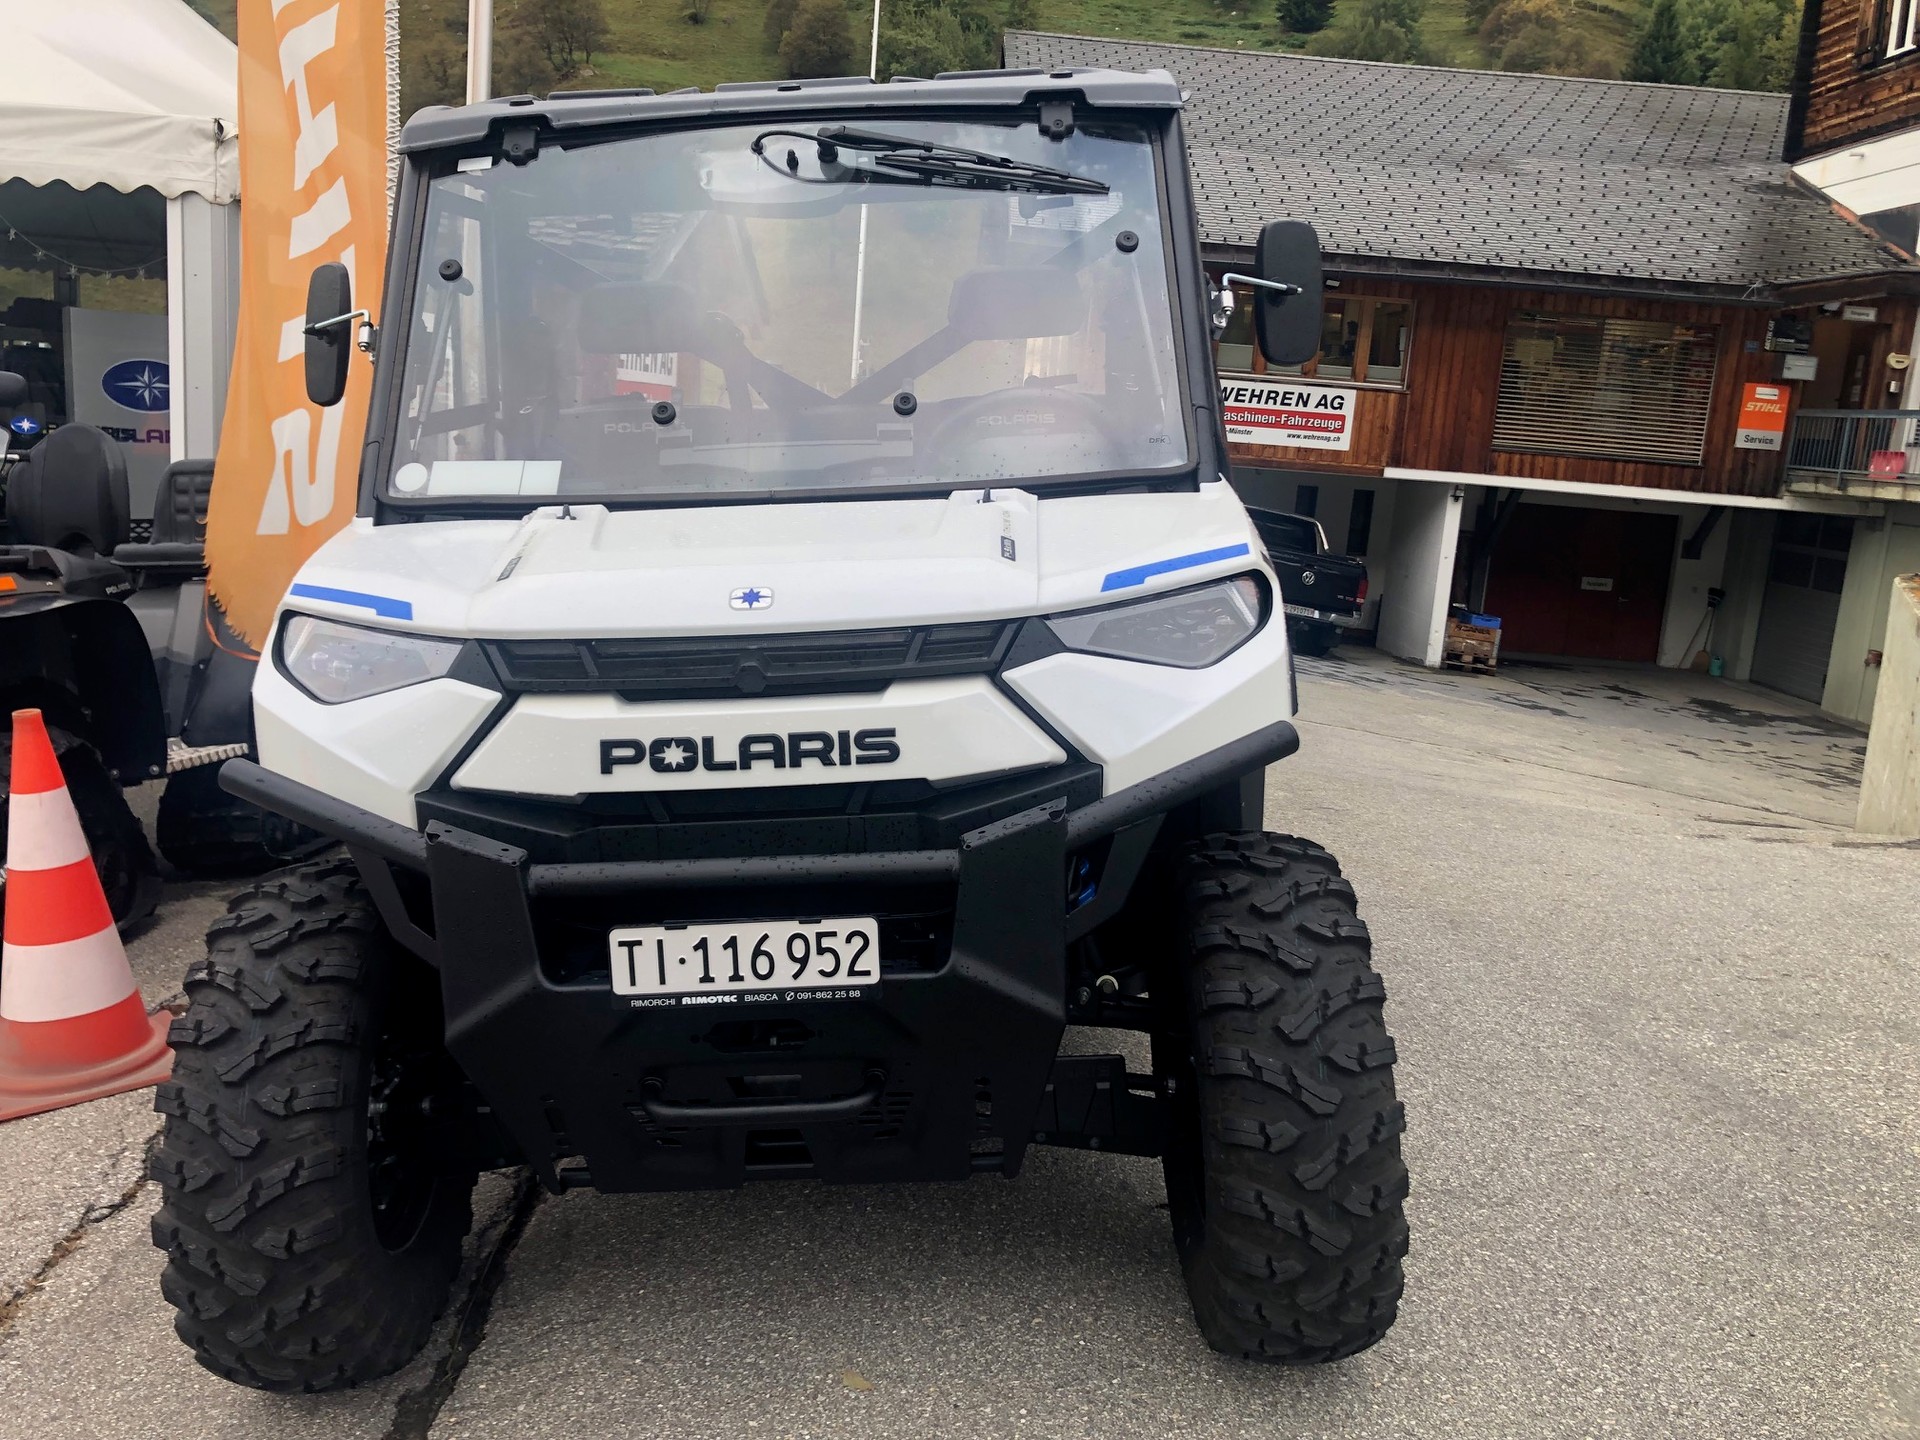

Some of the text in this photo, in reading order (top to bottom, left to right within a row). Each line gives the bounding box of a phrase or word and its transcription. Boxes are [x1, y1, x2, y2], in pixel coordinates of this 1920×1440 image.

[1314, 394, 1345, 411] AG
[1745, 401, 1783, 413] STIHL
[976, 413, 1056, 426] POLARIS
[1224, 411, 1342, 430] aschinen-Fahrzeuge
[1286, 432, 1341, 443] www.wehrenag.ch
[1743, 434, 1775, 445] Service
[600, 727, 900, 775] POLARIS
[631, 990, 861, 1008] RIMORCHI RIMOTEC BIASCA 091-862 25 88
